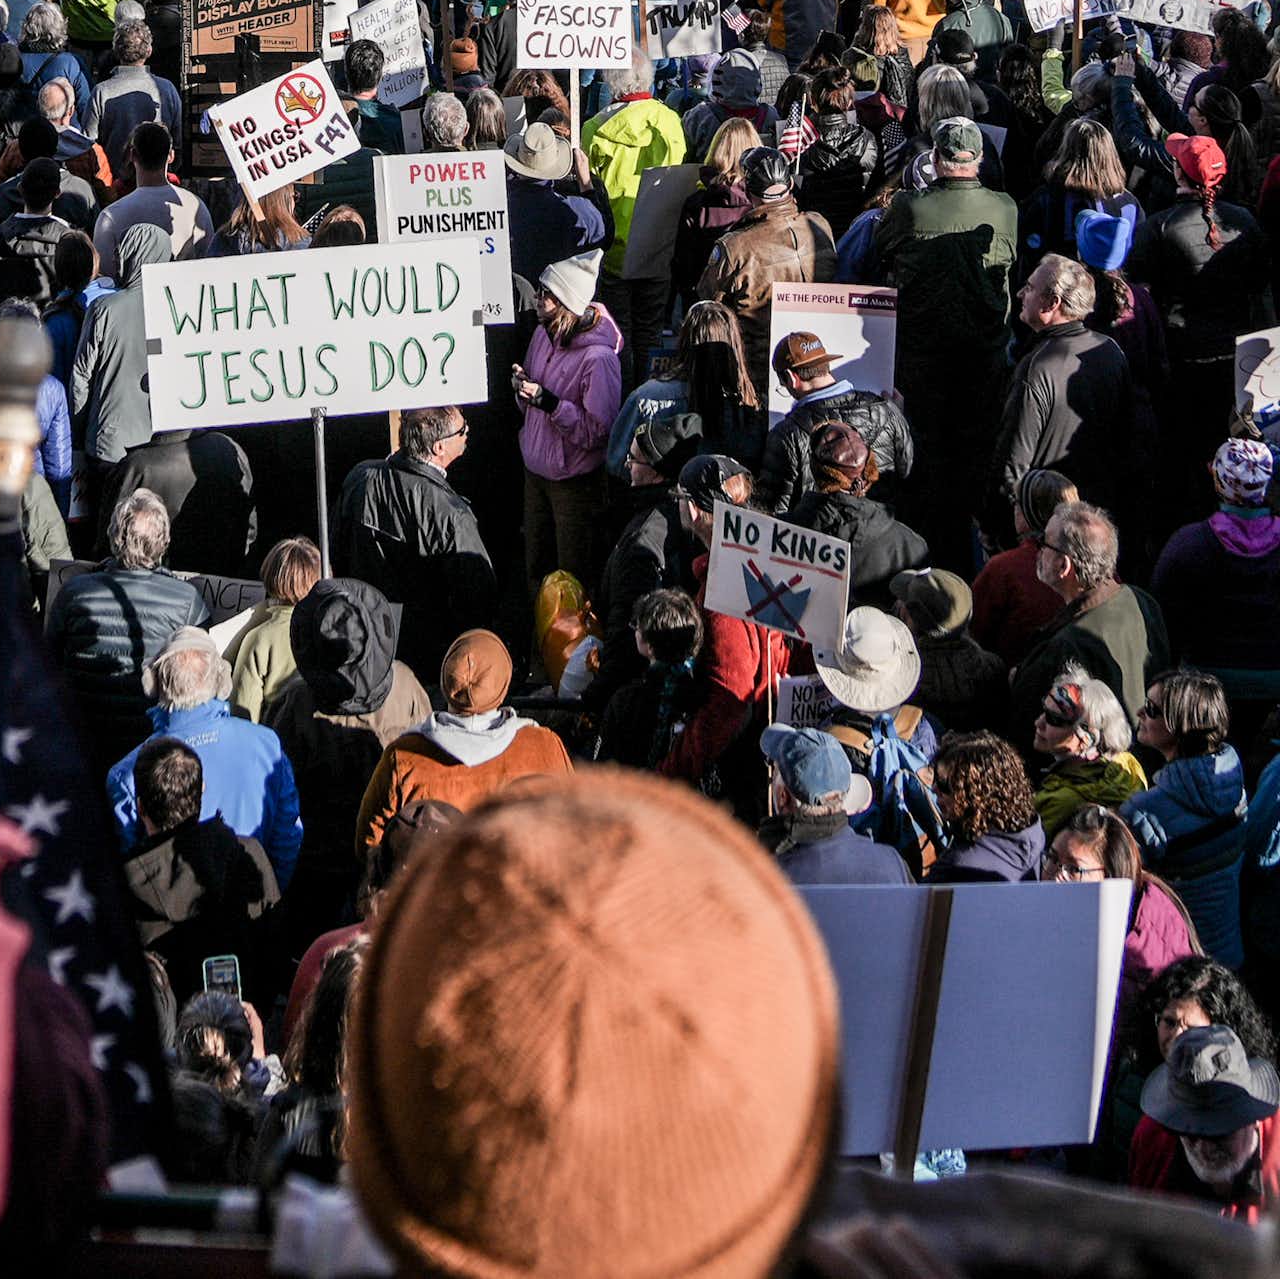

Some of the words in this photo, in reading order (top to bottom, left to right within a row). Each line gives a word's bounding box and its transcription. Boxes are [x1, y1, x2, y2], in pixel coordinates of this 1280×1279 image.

[198, 0, 255, 24] DISPLAY
[356, 8, 390, 33] HEALTH
[534, 5, 623, 28] FASCIST
[1038, 0, 1060, 19] NO
[216, 25, 235, 36] WITH
[238, 12, 291, 33] HEADER
[373, 21, 392, 40] CUT
[394, 24, 417, 45] GETS
[525, 30, 627, 61] CLOWNS
[399, 57, 418, 73] FOR
[229, 116, 257, 142] NO
[238, 116, 304, 163] KINGS!
[315, 111, 352, 155] F47
[248, 160, 270, 181] IN
[271, 139, 312, 171] USA
[409, 161, 487, 185] POWER
[425, 186, 473, 208] PLUS
[397, 209, 506, 236] PUNISHMENT
[164, 272, 297, 336] WHAT
[324, 260, 461, 321] WOULD
[776, 292, 791, 302] WE
[793, 293, 810, 303] THE
[811, 294, 845, 305] PEOPLE
[179, 342, 340, 411] JESUS
[368, 331, 458, 393] DO?
[722, 510, 760, 546] NO
[770, 522, 847, 573] KINGS
[791, 684, 812, 703] NO
